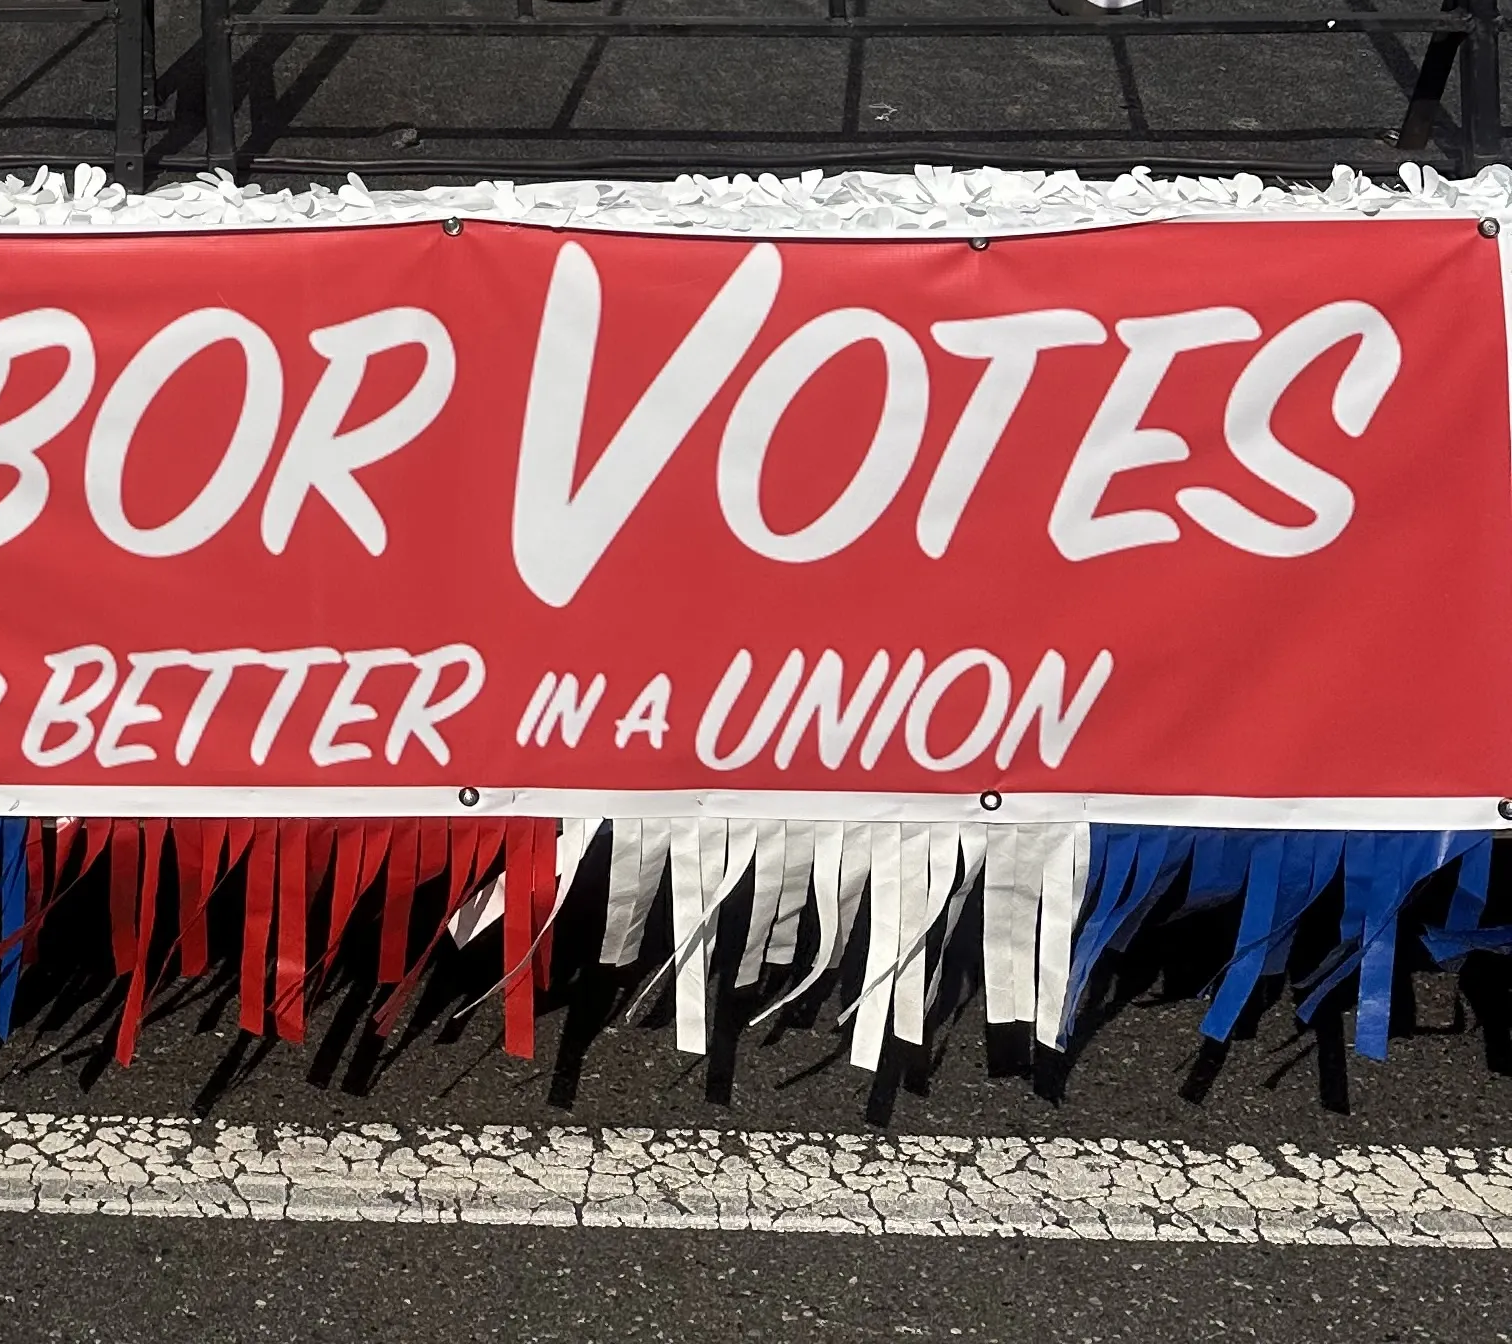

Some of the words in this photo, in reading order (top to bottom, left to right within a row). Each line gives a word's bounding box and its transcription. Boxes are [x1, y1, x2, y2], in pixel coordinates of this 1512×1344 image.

[510, 240, 1404, 609] VOTES
[25, 648, 487, 771] BETTER
[516, 672, 588, 749] IN
[613, 676, 672, 750] A
[693, 648, 1114, 774] UNION
